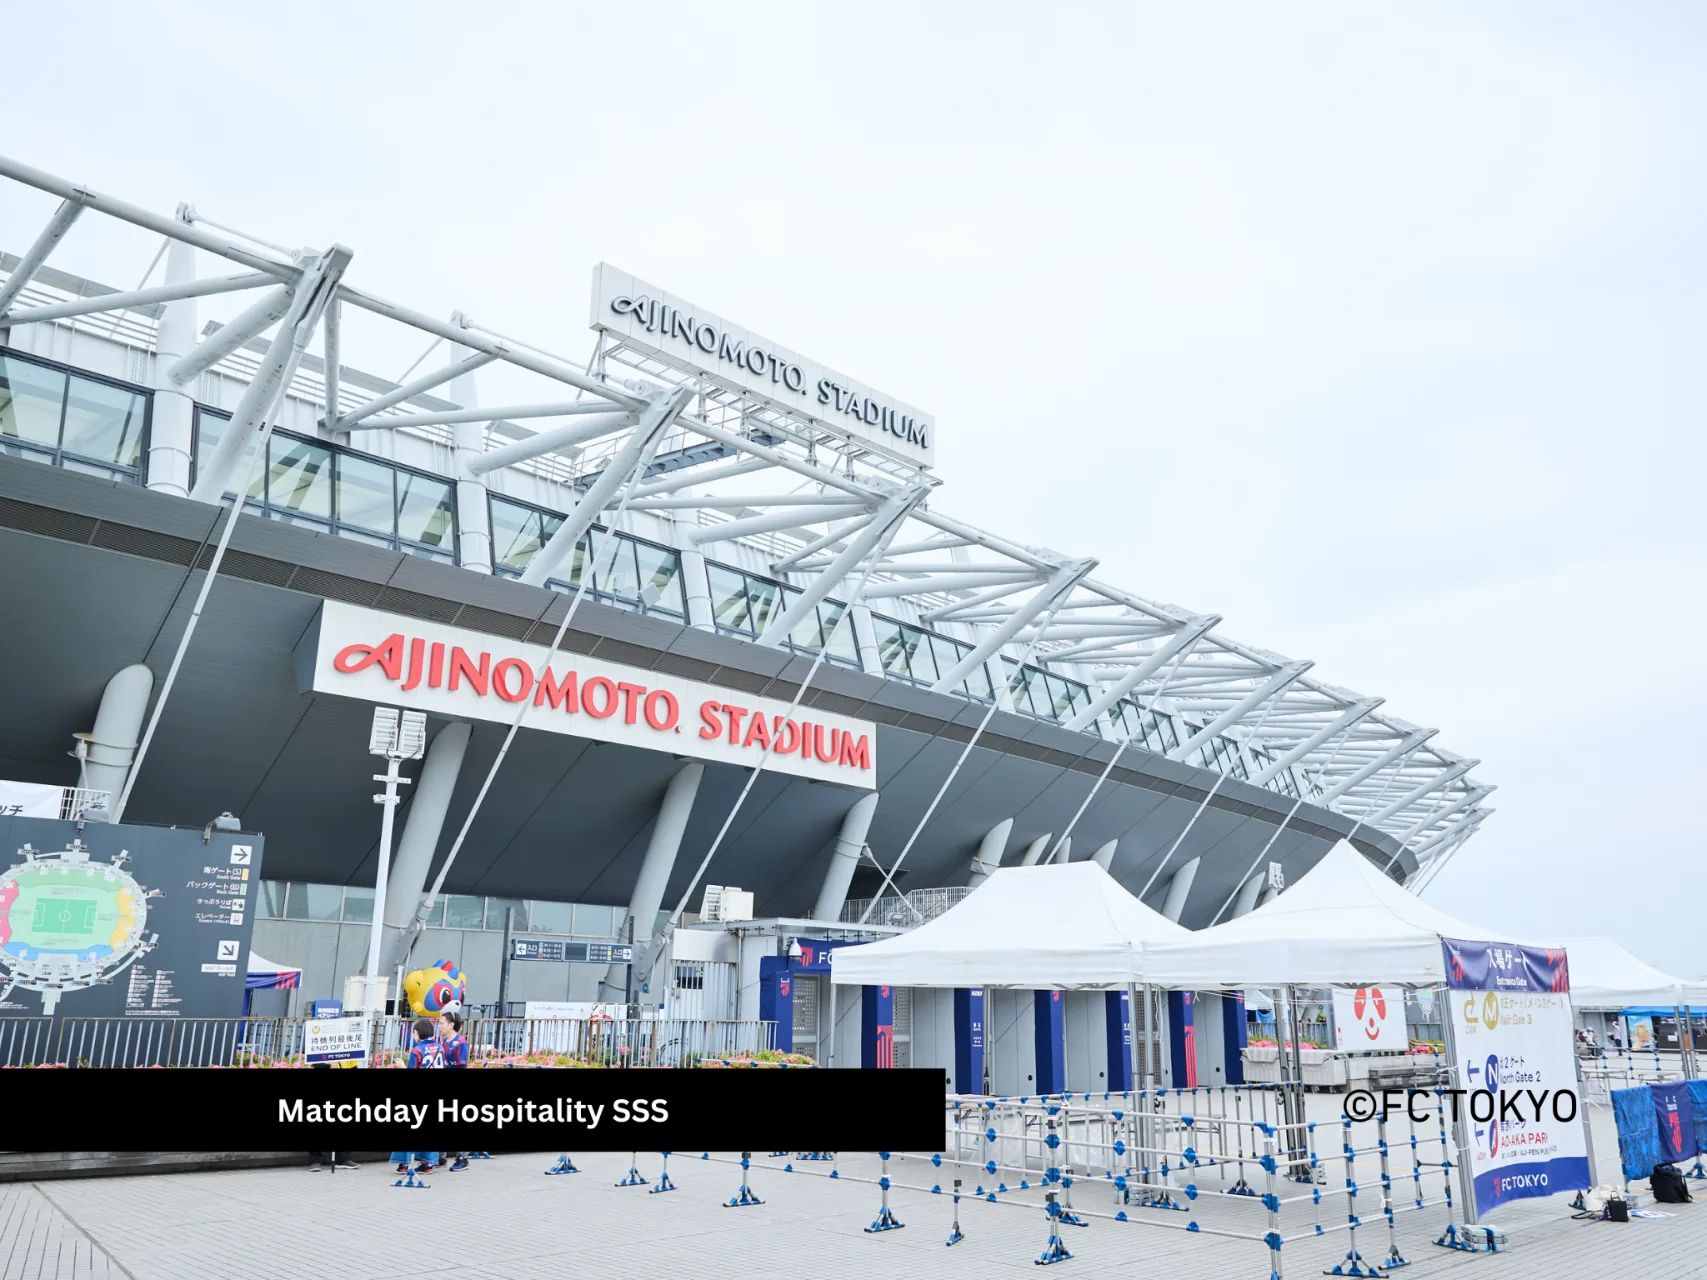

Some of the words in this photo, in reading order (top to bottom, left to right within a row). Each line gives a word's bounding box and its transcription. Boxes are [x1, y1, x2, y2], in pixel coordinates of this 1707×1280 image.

[817, 378, 929, 449] STADIUM
[700, 700, 871, 771] STADIUM
[1527, 1013, 1532, 1025] 3
[311, 1034, 362, 1044] 待機列最後尾
[1515, 1072, 1533, 1082] Gate
[1536, 1071, 1540, 1082] 2
[1501, 1133, 1526, 1148] AO-AKA
[1502, 1176, 1512, 1191] FC
[1512, 1174, 1548, 1189] TOKYO
